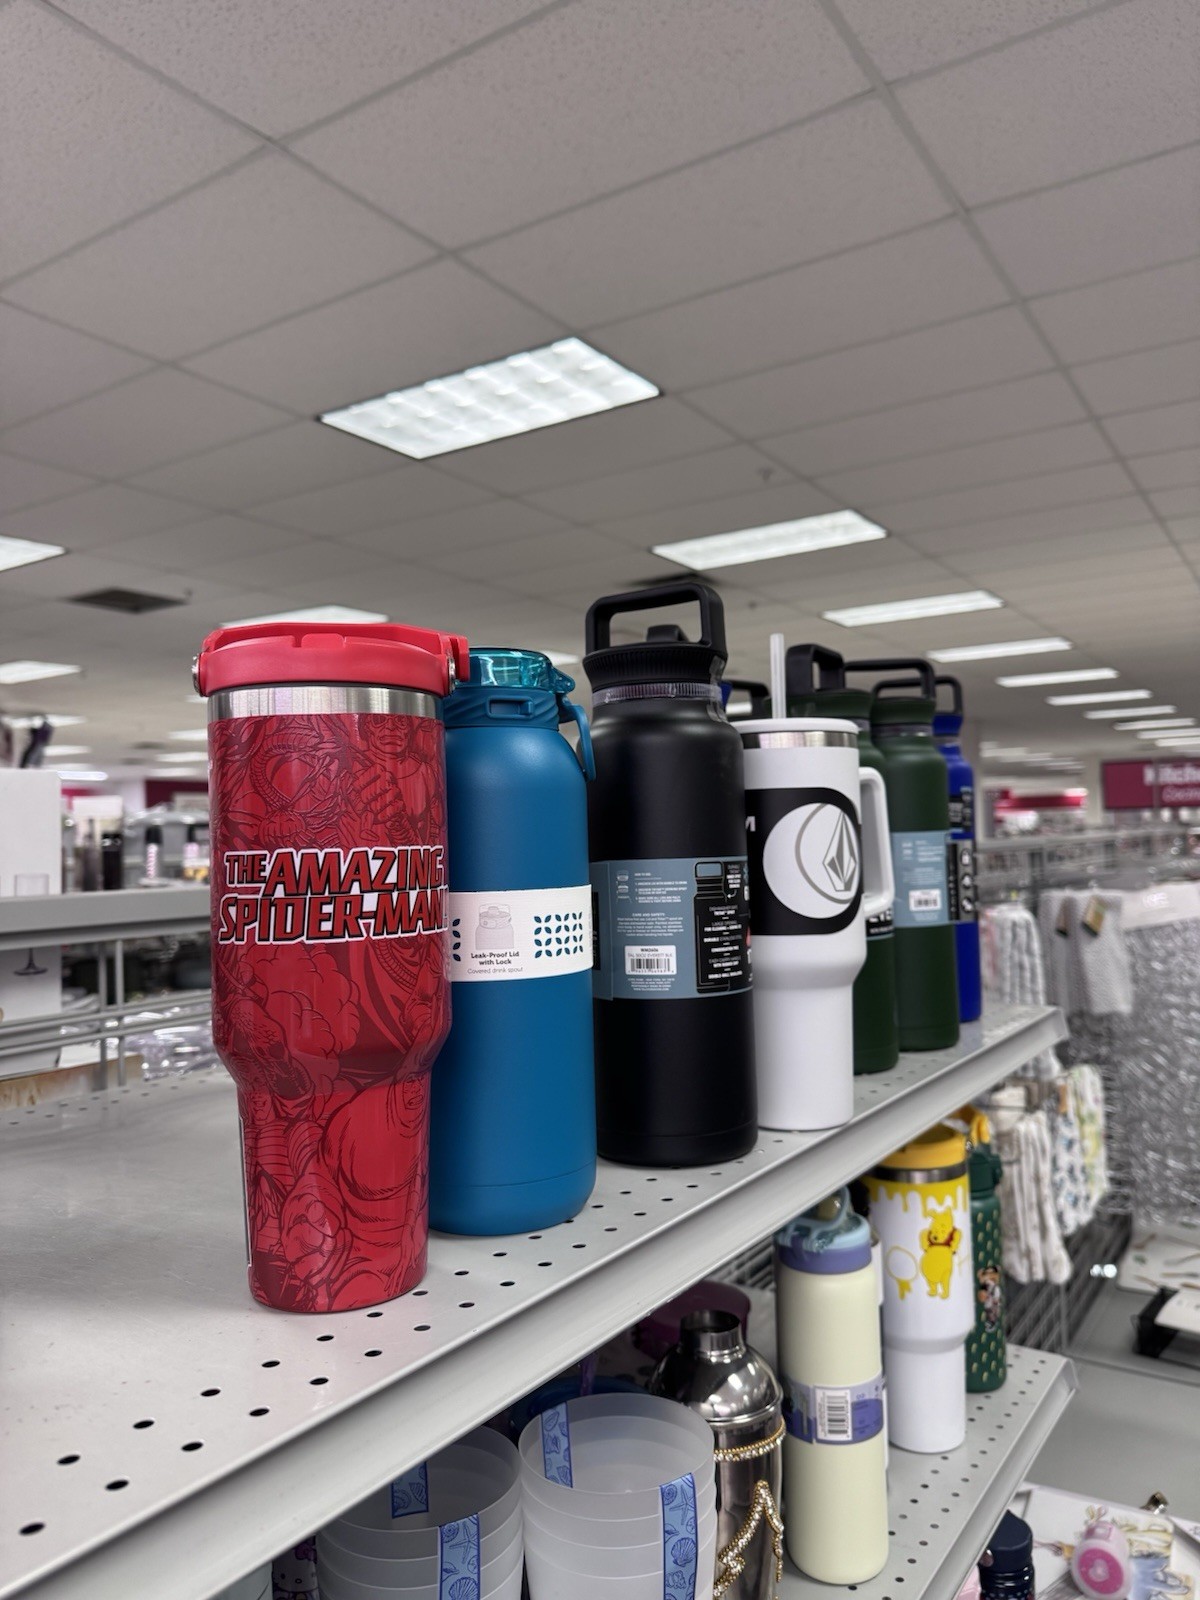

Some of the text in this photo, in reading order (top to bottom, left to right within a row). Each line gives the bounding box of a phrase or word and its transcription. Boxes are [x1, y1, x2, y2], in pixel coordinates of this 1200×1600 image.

[225, 847, 444, 898] THE AMAZING
[219, 889, 448, 944] SPIDER-MAN
